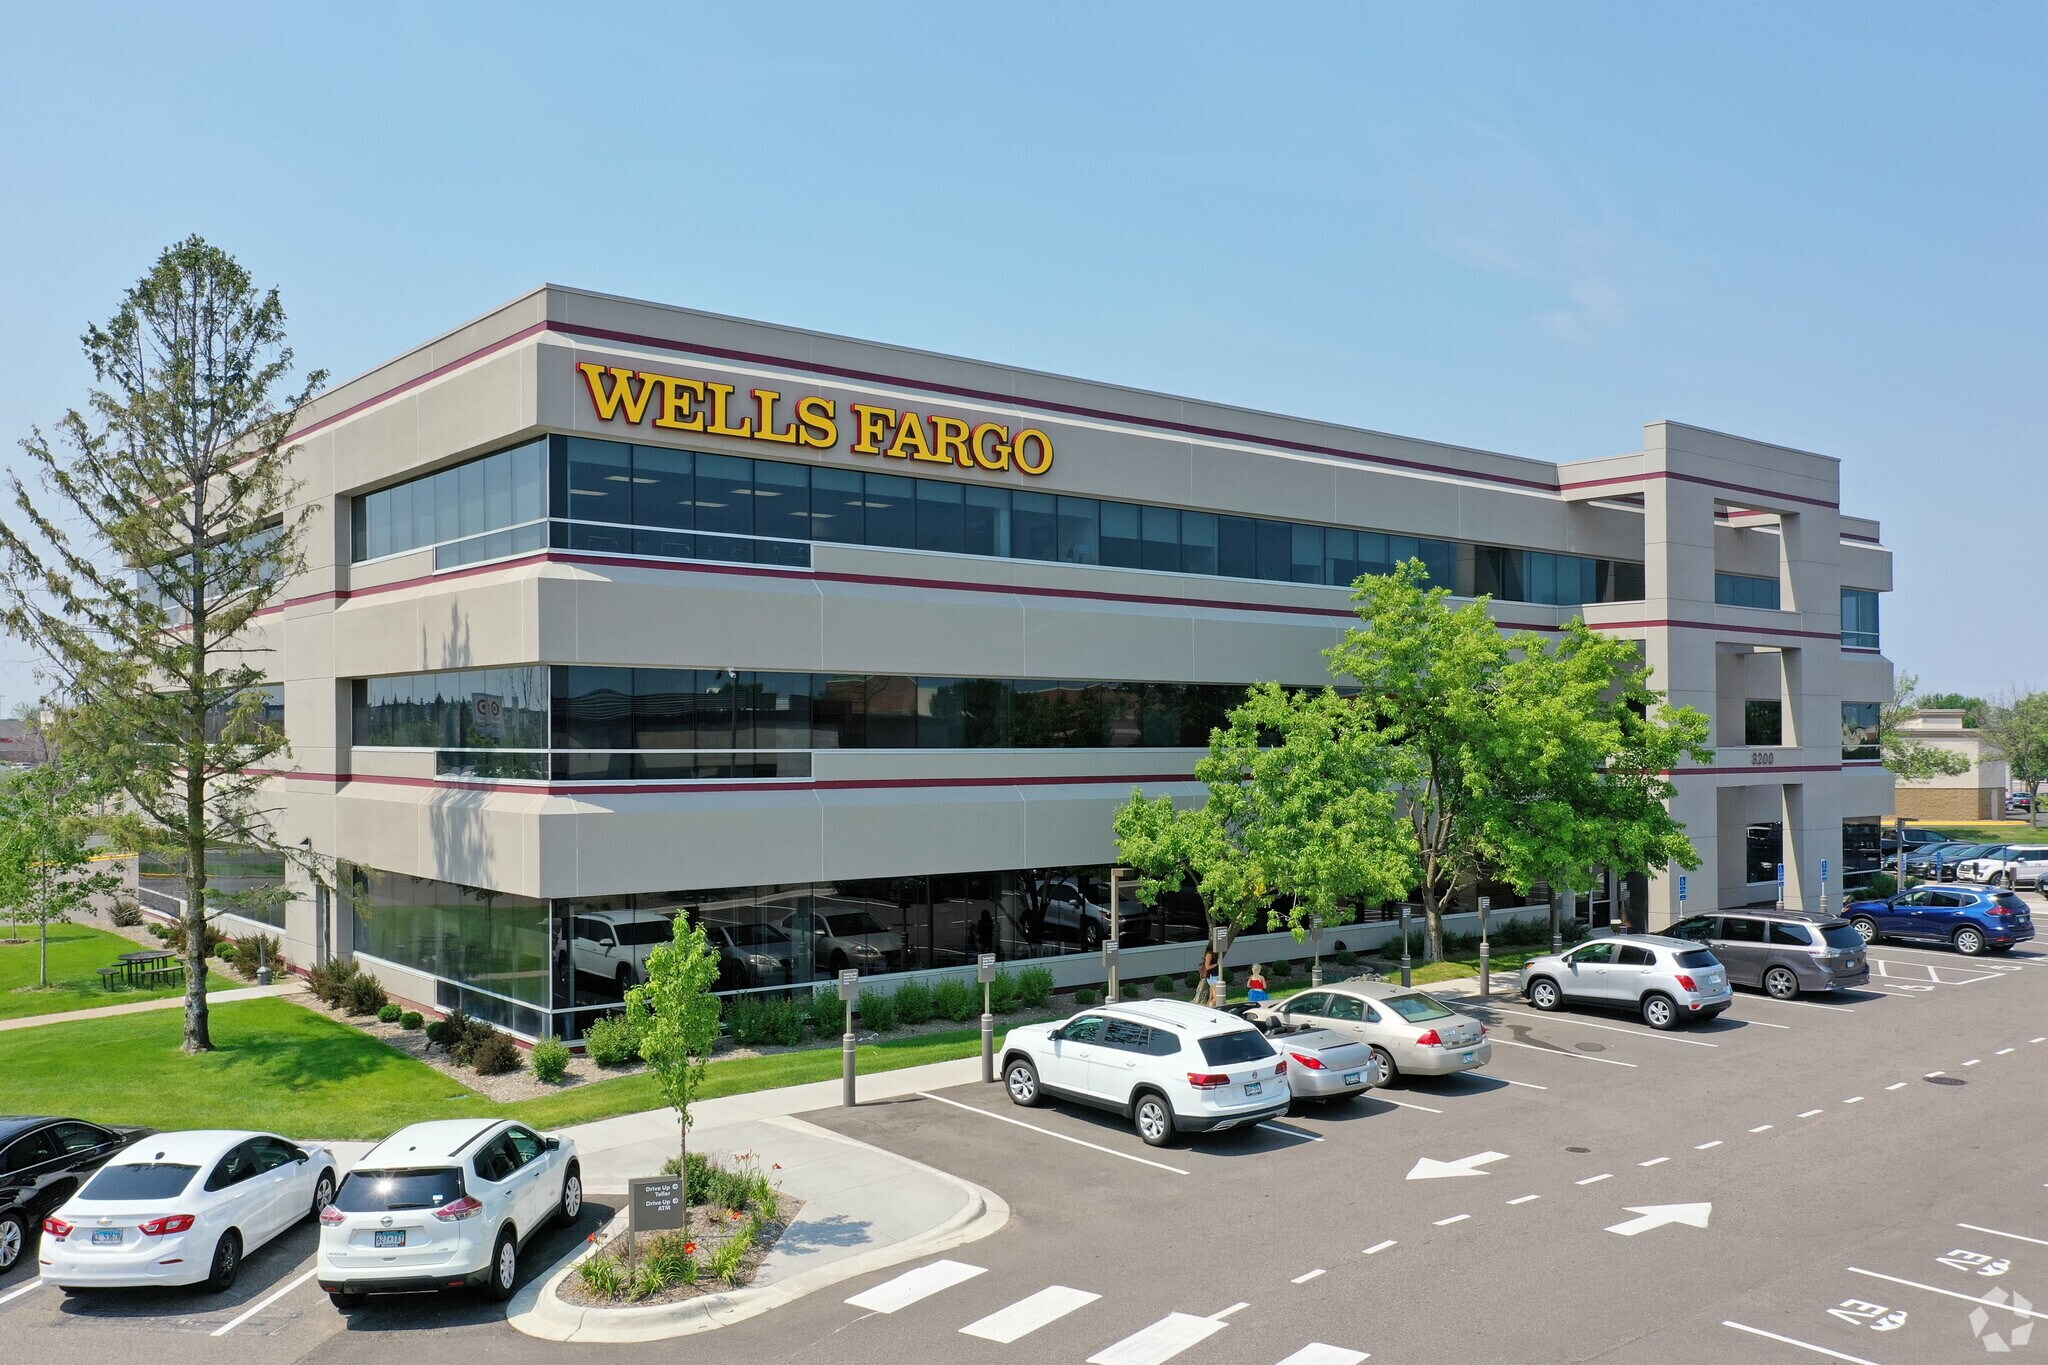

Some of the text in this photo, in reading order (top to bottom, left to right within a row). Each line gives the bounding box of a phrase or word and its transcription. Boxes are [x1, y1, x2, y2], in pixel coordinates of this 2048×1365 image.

[576, 361, 1055, 476] WELLS FARGO
[1751, 752, 1774, 765] 3200
[1935, 1249, 1993, 1271] EV
[1826, 1298, 1890, 1326] EV
